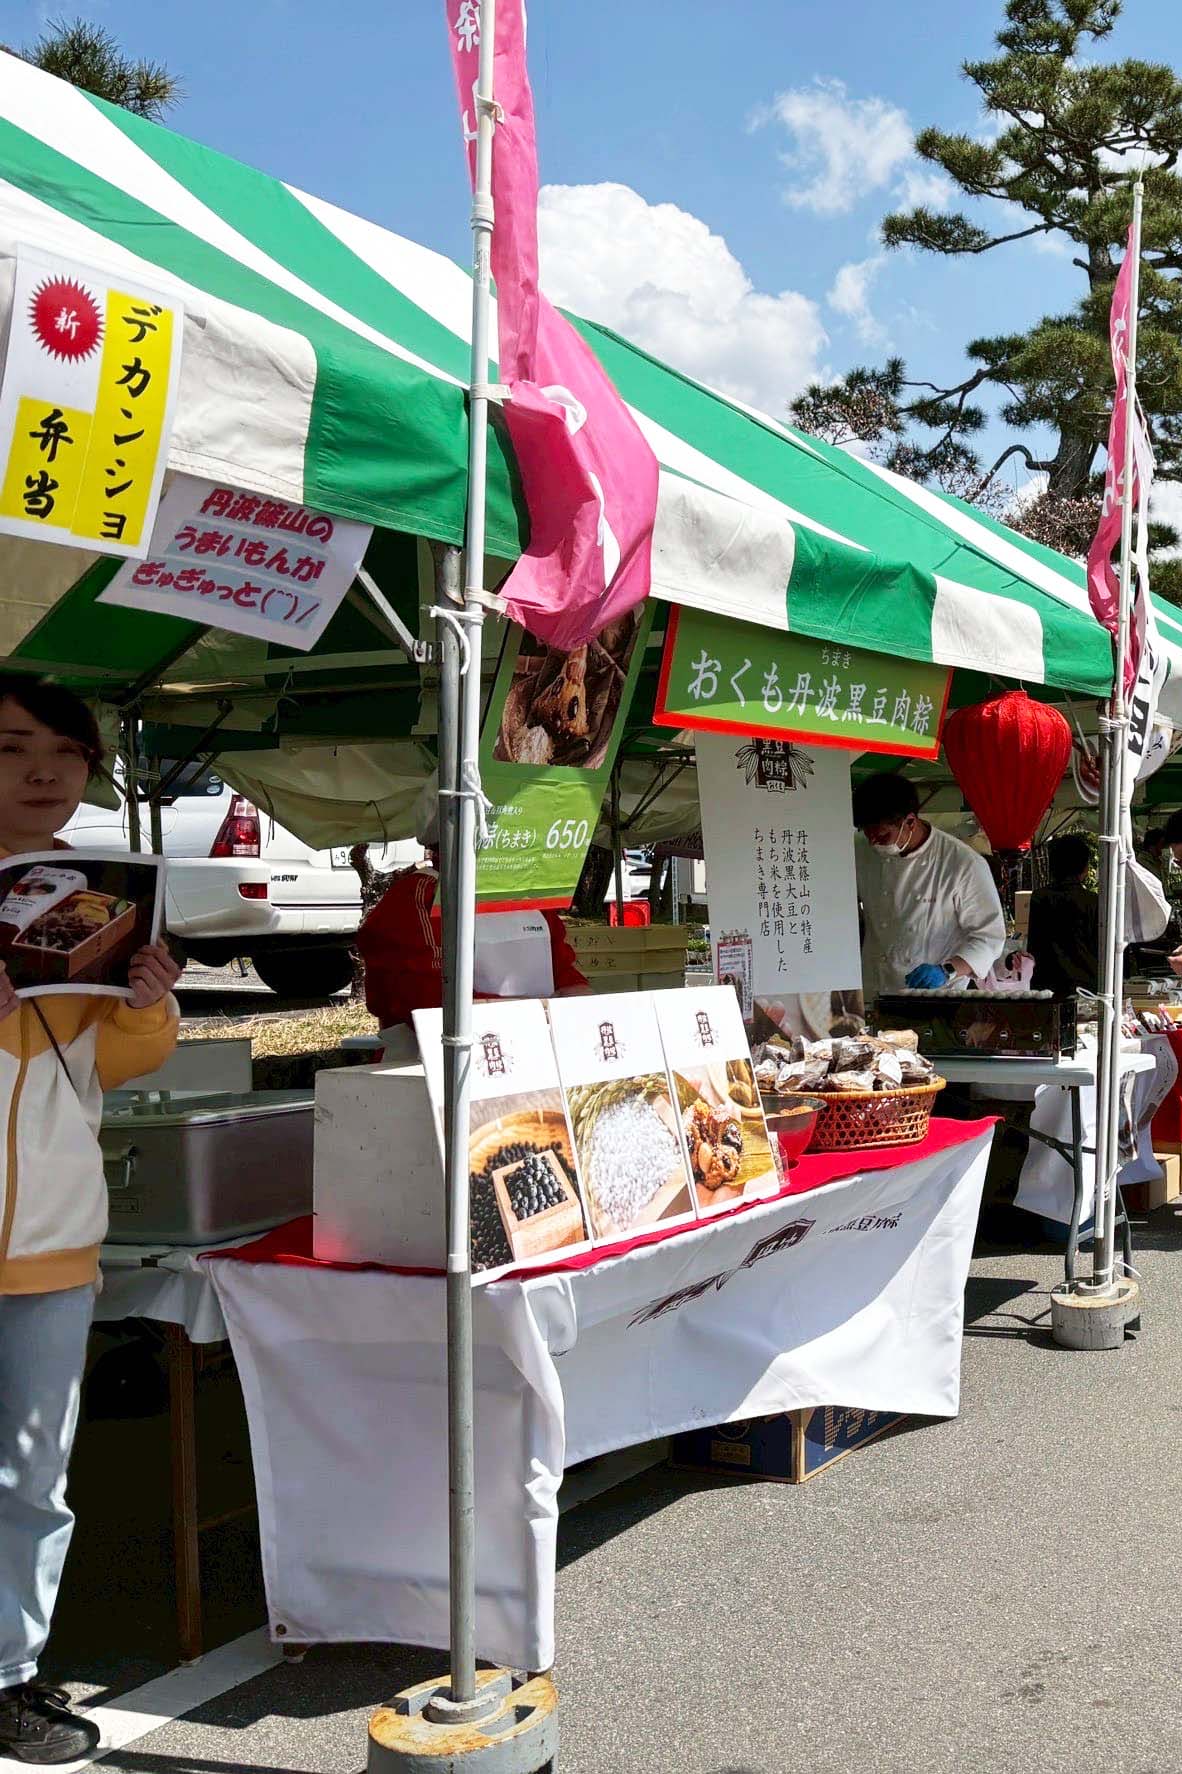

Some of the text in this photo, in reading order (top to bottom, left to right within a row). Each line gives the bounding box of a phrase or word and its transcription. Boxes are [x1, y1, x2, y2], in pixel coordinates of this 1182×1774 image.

[53, 306, 82, 341] 新
[22, 407, 75, 519] 弁当
[99, 304, 163, 541] デカンショ
[174, 525, 327, 584] うまいもんが
[199, 487, 335, 544] 丹波篠山の
[687, 649, 934, 736] おくも丹波黒豆肉粽
[820, 645, 853, 669] ちまき
[753, 827, 771, 937] ちまき専門店
[769, 828, 788, 973] もち米を使用した
[781, 829, 798, 936] 丹波黒大豆と
[796, 829, 813, 954] 丹波篠山の特産
